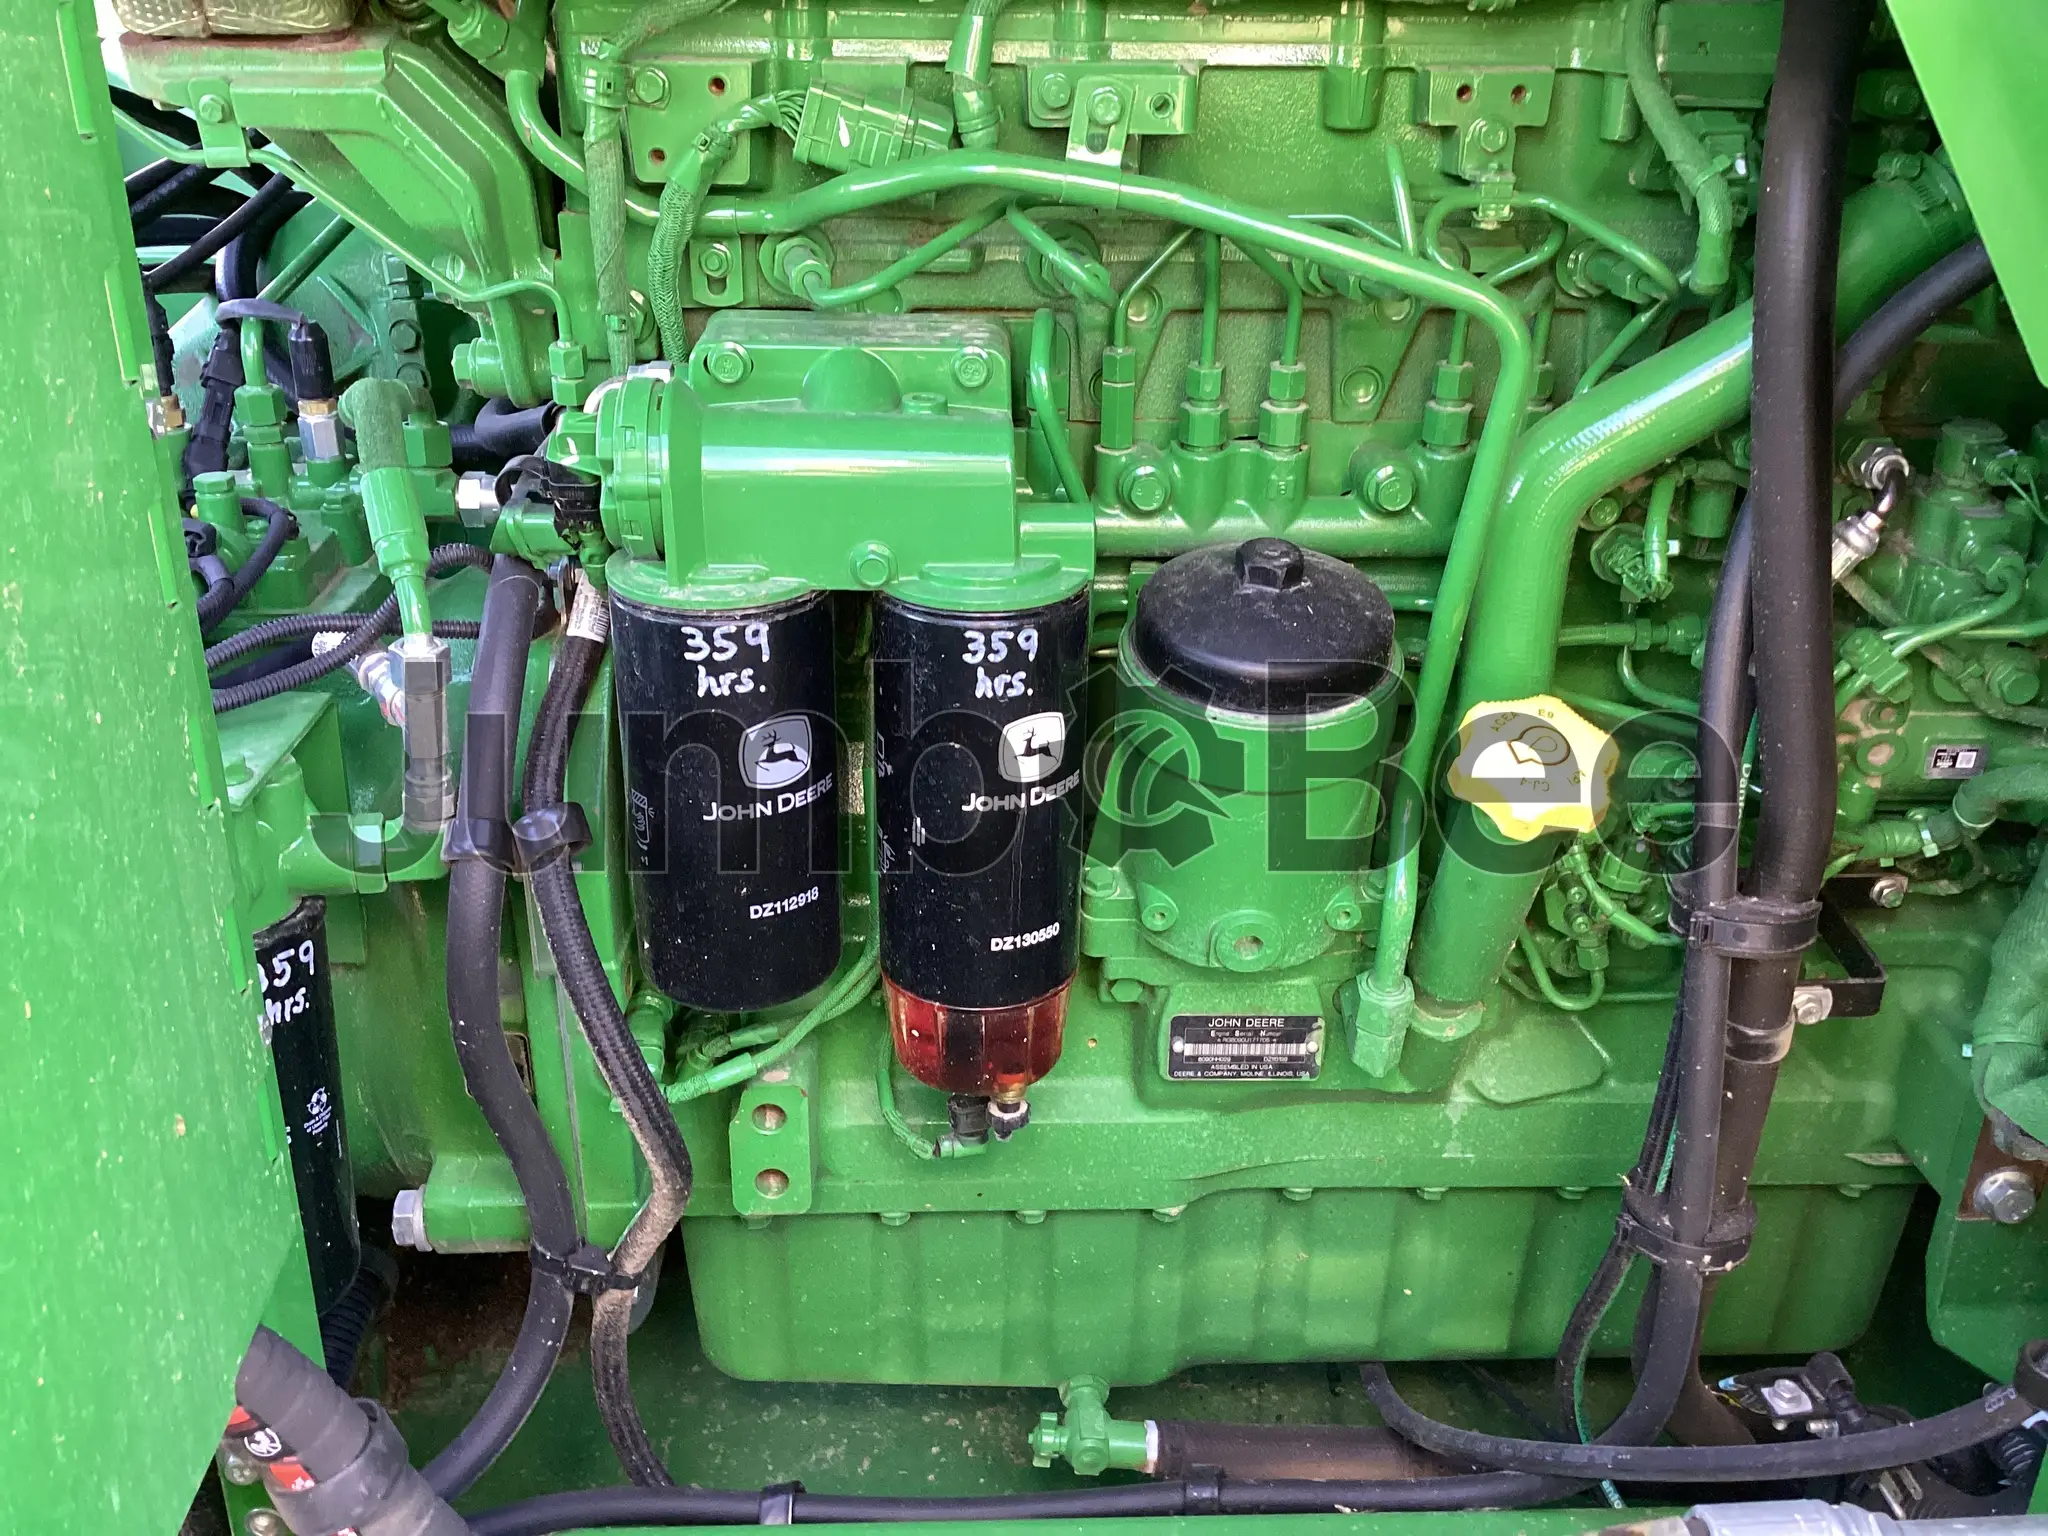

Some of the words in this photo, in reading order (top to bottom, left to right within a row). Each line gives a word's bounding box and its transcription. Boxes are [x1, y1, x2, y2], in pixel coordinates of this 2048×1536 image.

[681, 622, 770, 662] 359
[961, 627, 1039, 664] 359
[697, 664, 767, 698] hrs.
[974, 665, 1034, 699] hrs.
[702, 801, 773, 821] JOHN
[777, 772, 833, 814] DEERE
[961, 792, 1026, 812] JOHN
[1029, 768, 1080, 806] DEERE
[749, 886, 819, 919] DZ112918
[990, 922, 1060, 951] DZ130550
[1208, 1018, 1242, 1028] JOHN
[1245, 1018, 1285, 1028] DEERE
